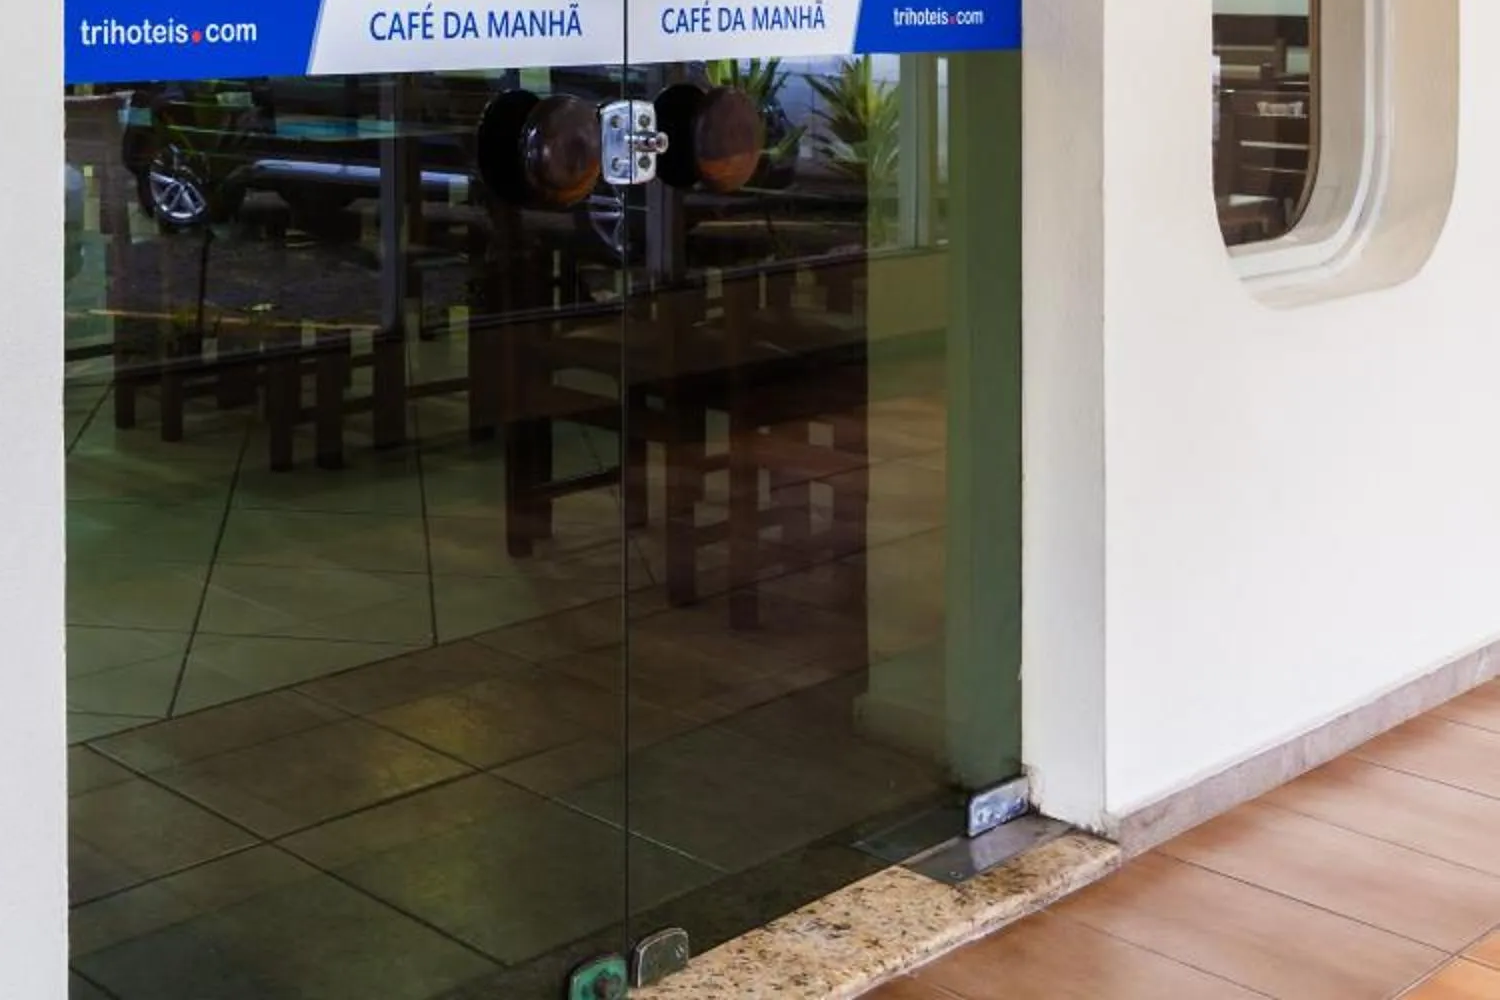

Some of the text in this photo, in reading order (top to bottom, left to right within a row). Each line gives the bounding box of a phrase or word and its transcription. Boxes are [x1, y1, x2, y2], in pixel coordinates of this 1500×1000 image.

[80, 17, 258, 46] trihoteis.com
[369, 2, 583, 41] CAFÉ DA MANHÃ
[661, 0, 827, 34] CAFÉ DA MANHÃ
[893, 7, 985, 28] trihoteis.com
